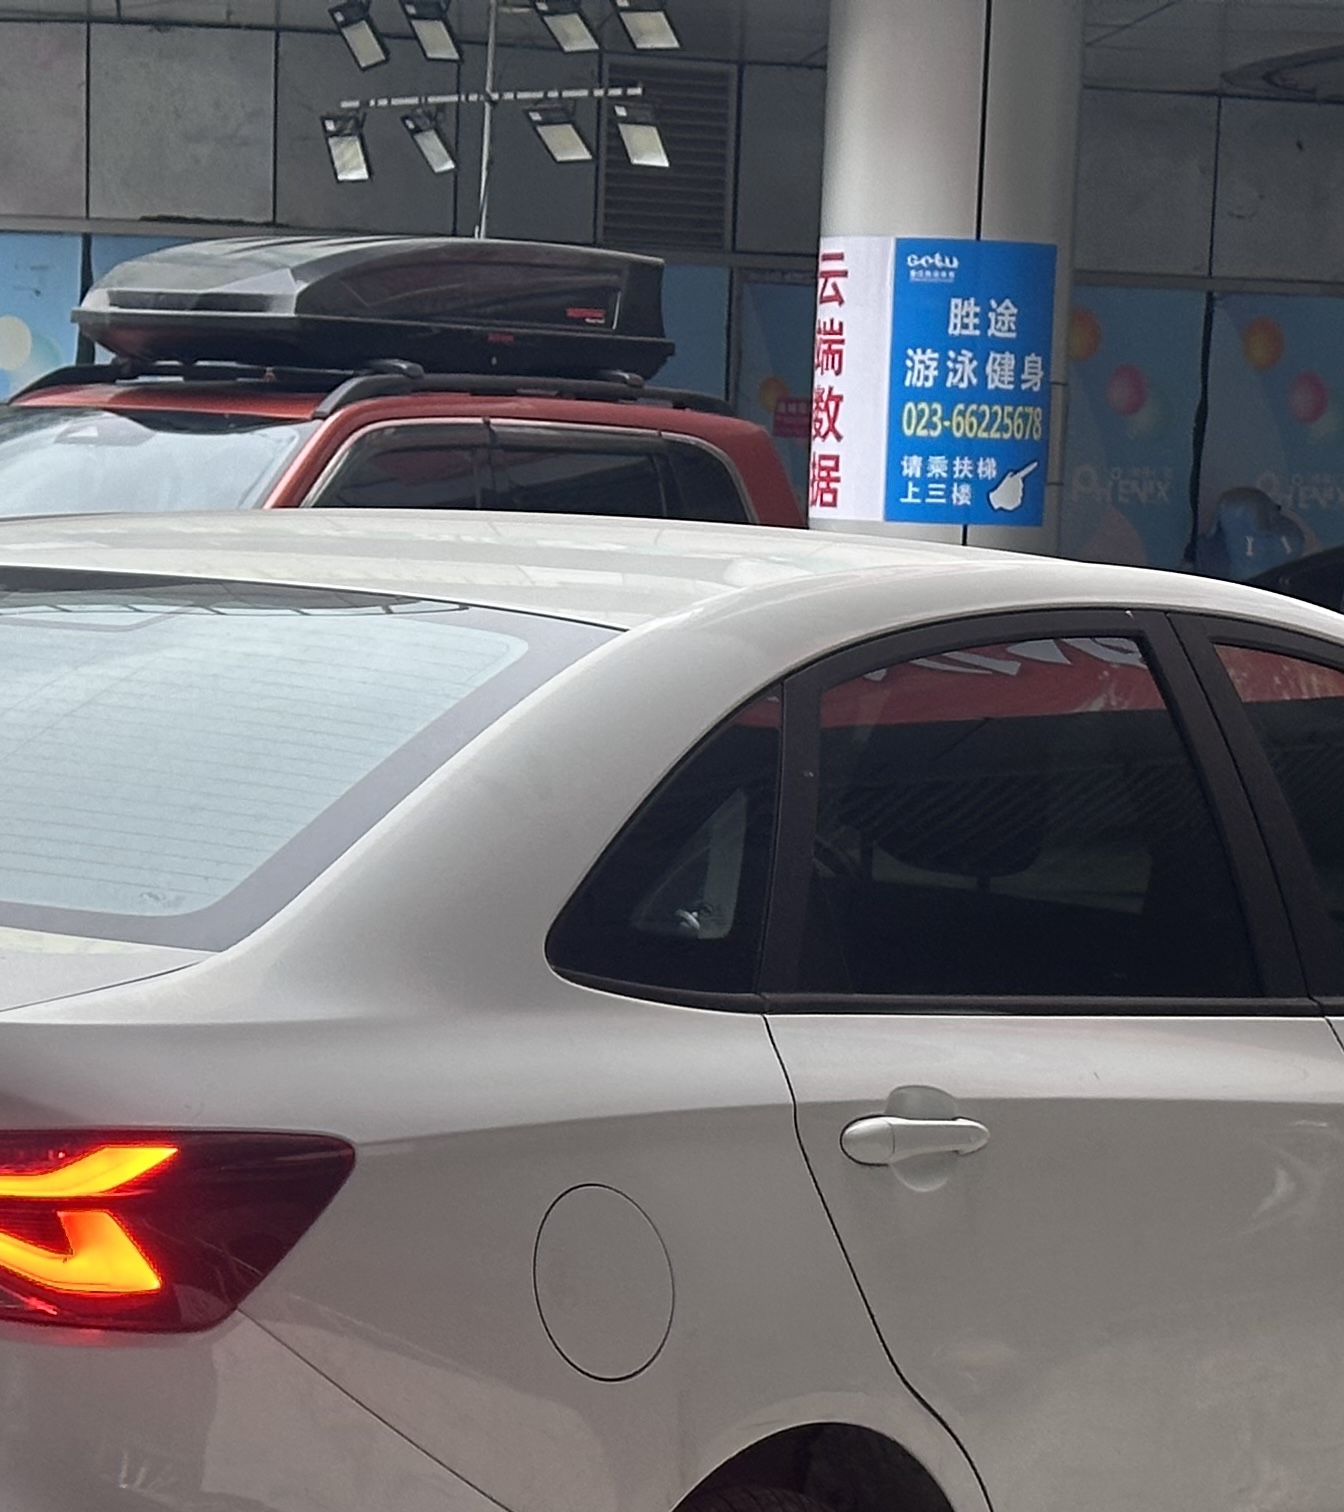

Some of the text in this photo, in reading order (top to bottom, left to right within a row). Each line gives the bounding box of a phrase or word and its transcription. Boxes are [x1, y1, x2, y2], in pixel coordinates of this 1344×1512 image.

[947, 296, 1019, 340] 胜途
[810, 251, 849, 509] 云端数据
[904, 347, 1045, 393] 游泳健身
[901, 401, 1043, 442] 023-66225678
[900, 454, 998, 481] 请乘扶梯
[899, 481, 973, 507] 上三楼
